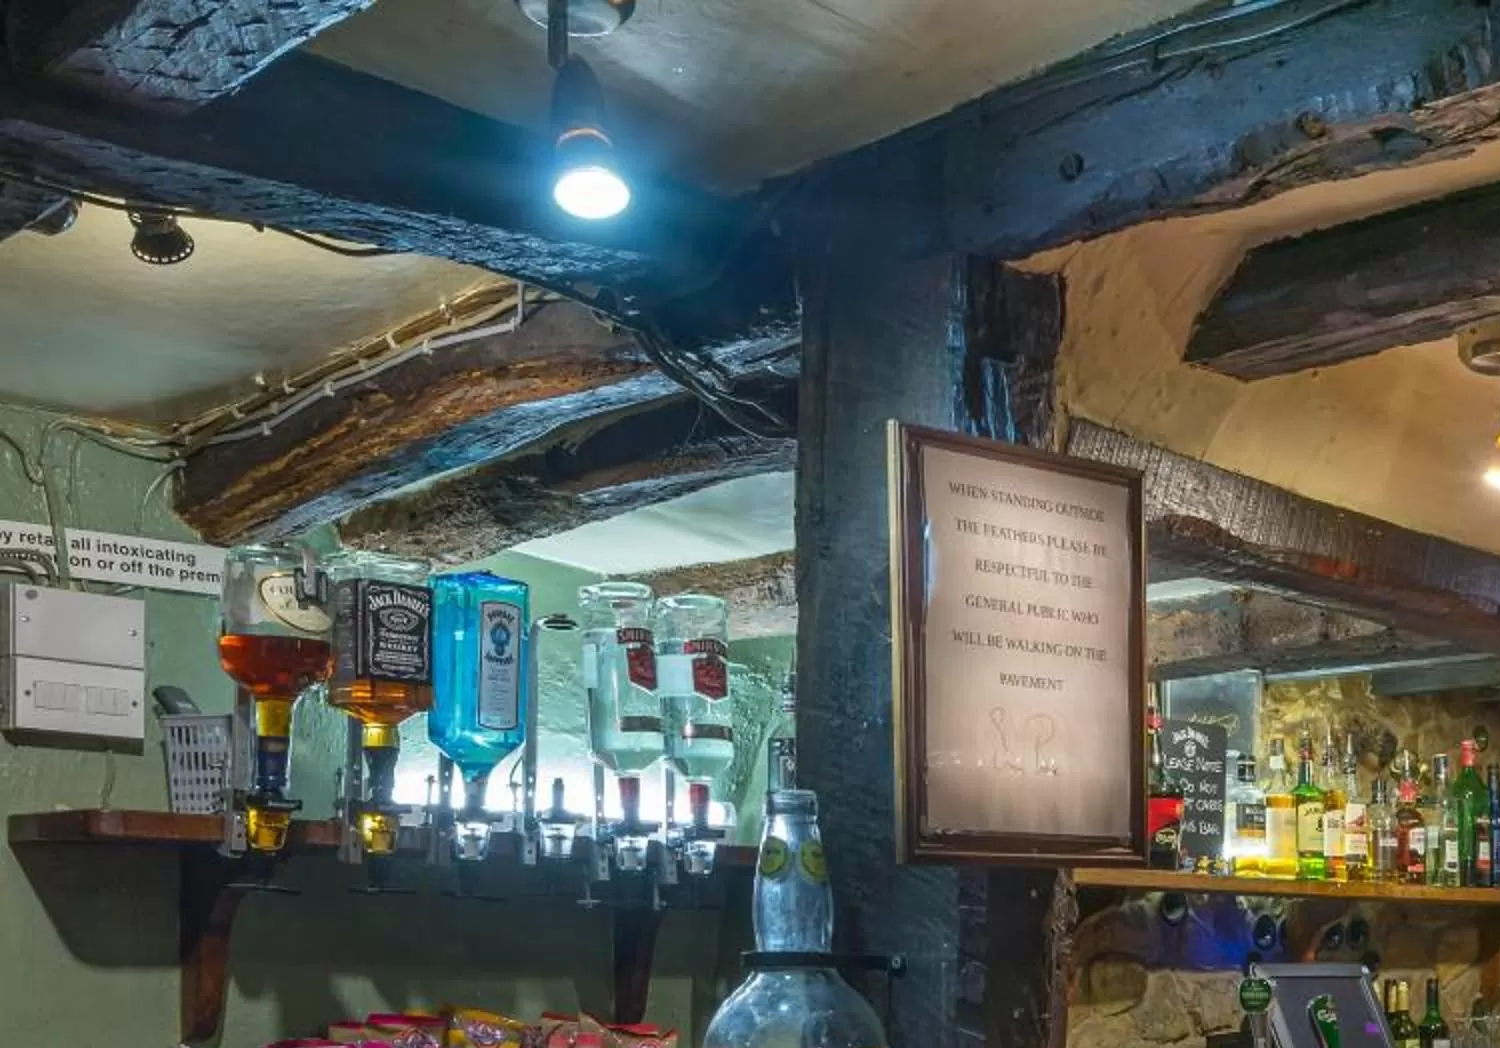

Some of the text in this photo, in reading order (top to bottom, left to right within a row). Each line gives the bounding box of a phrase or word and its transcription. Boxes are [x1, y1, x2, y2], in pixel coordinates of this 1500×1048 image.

[949, 481, 1105, 523] WHEN STANDING OUTSIDE
[19, 531, 55, 546] reta
[71, 537, 91, 551] all
[97, 543, 196, 566] intoxicating
[956, 518, 980, 534] THE
[1047, 535, 1090, 554] PLEASE
[70, 555, 91, 568] on
[98, 559, 114, 571] or
[120, 560, 143, 574] off
[148, 563, 174, 578] the
[975, 558, 1094, 588] RESPECTFUL TO THE
[368, 592, 392, 610] JACK
[965, 593, 1099, 624] GENERAL PUBLIC WHO
[952, 628, 1107, 661] WILL BE WALKING ON THE
[1000, 672, 1064, 692] PAVEMENT
